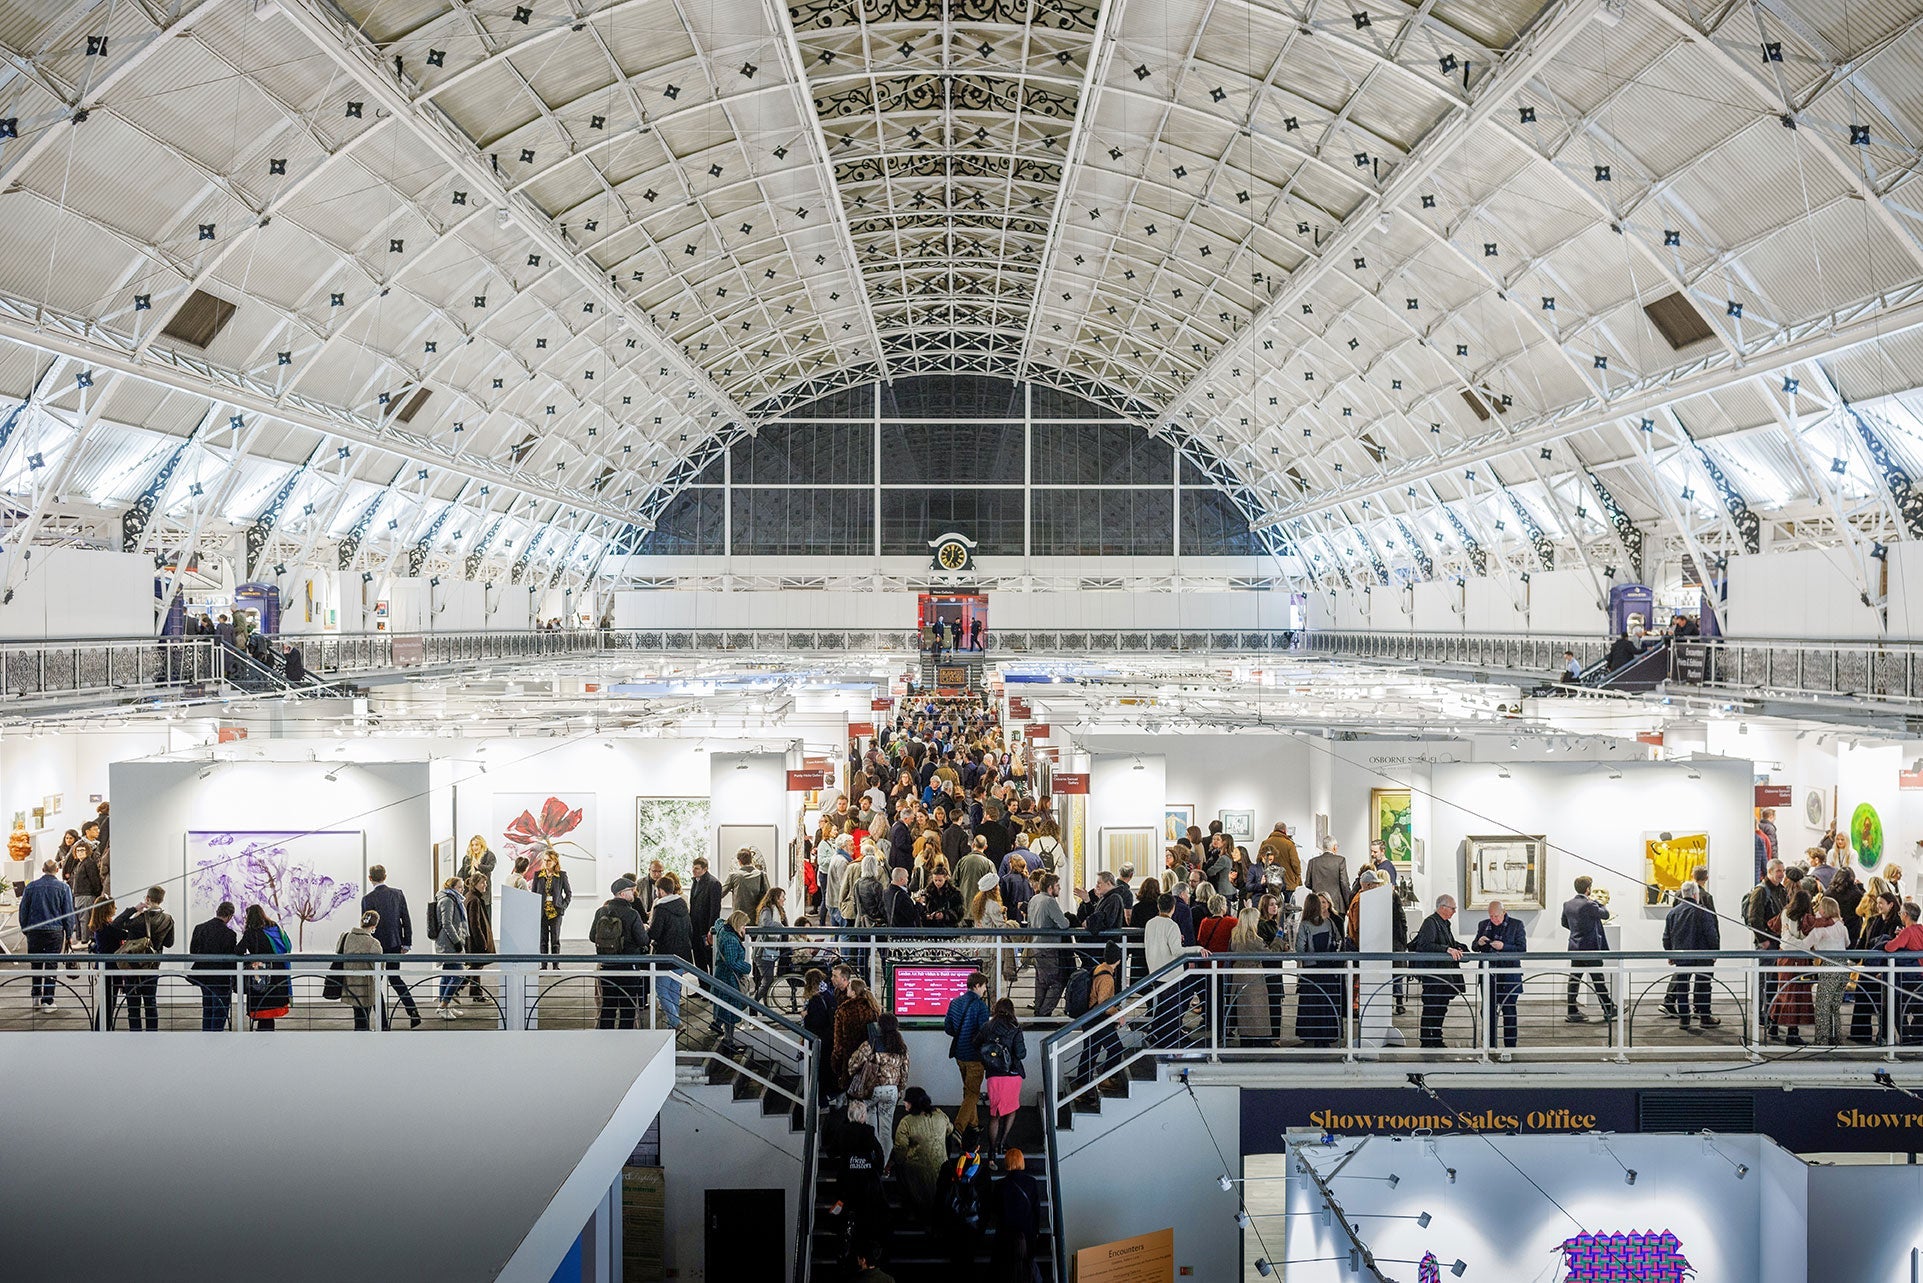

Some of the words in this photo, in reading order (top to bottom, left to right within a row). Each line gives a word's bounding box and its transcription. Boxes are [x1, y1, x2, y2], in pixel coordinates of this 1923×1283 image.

[1368, 756, 1405, 764] OSBORNE
[1309, 1109, 1453, 1129] Showrooms
[1458, 1109, 1519, 1129] Sales
[1526, 1109, 1597, 1129] Office
[1108, 1244, 1145, 1258] Encounters
